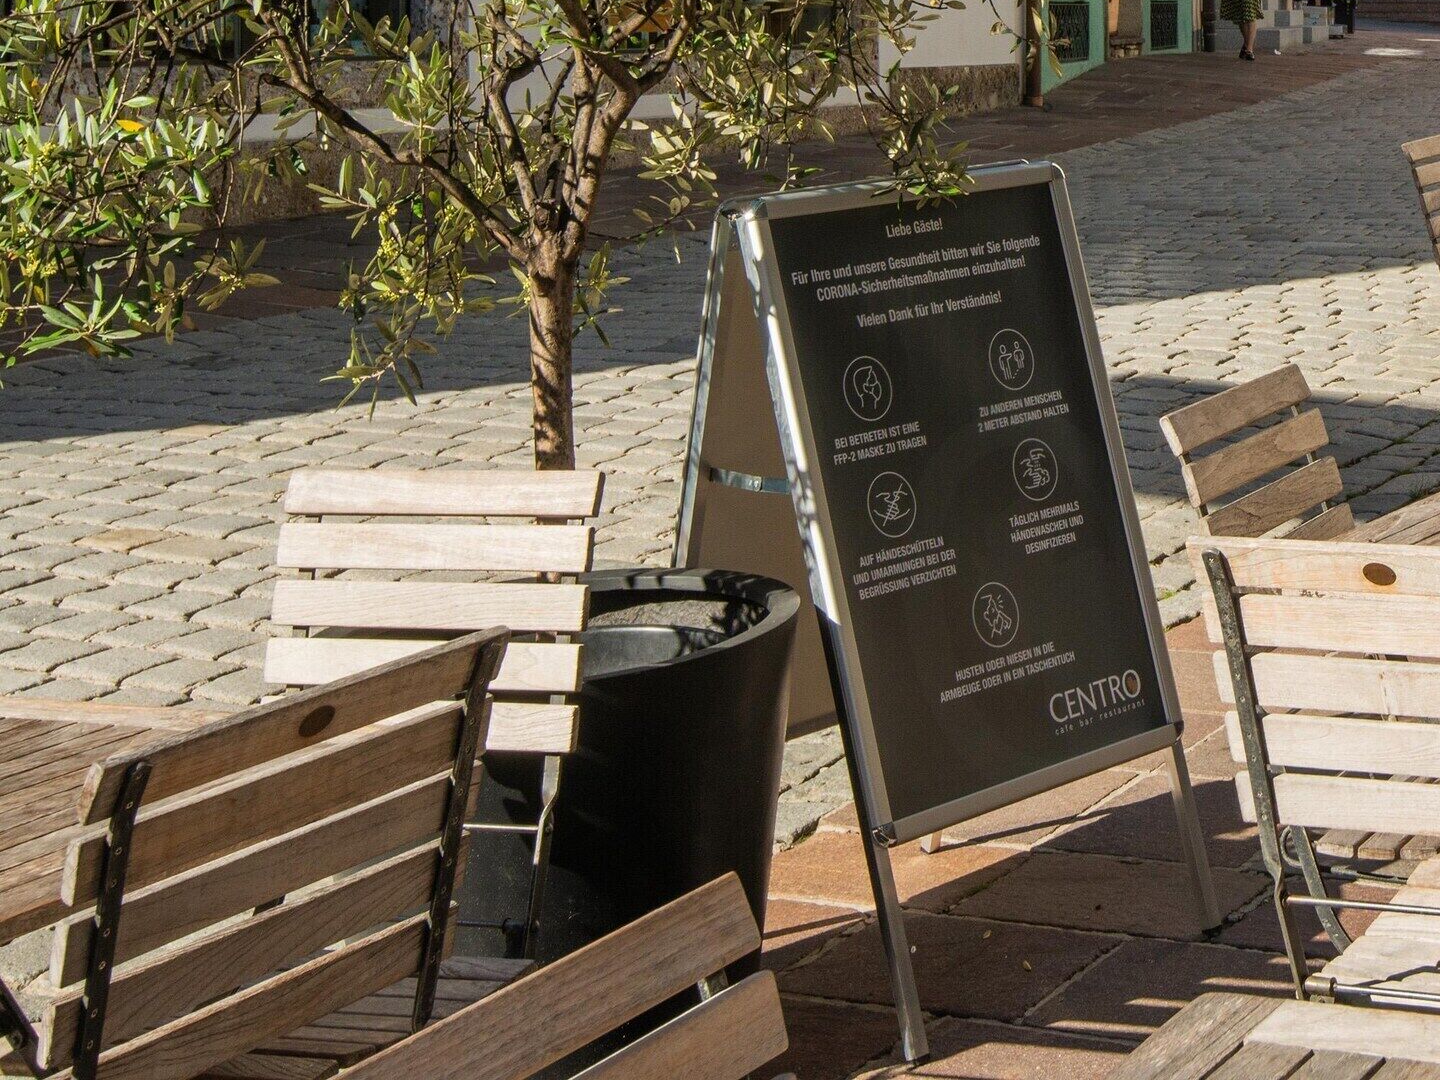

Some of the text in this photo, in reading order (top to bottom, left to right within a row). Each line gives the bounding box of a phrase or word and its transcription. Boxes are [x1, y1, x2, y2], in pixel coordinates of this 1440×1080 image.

[885, 218, 944, 238] Liebe Gäste!
[791, 235, 1041, 286] Für Ihre und unsere Gesundheit bitten wir Sie folgende
[816, 255, 1026, 302] CORONA-Sicherheitsmaßnahmen einzuhalten!
[856, 291, 1002, 327] Vielen Dank für Ihr Verständnis!
[977, 403, 1070, 433] 2 METER ABSTAND HALTEN
[979, 390, 1063, 418] ZU ANDEREN MENSCHEN
[833, 435, 927, 466] FFP-2 MASKE ZU TRAGEN
[834, 421, 920, 450] BEI BETRETEN IST EINE
[1009, 501, 1080, 528] TÄGLICH MEHRMALS
[1010, 514, 1084, 543] HÄNDEWASCHEN UND
[860, 536, 945, 568] AUF HÄNDESCHÜTTELN
[1025, 531, 1077, 554] DESINFIZIEREN
[853, 548, 957, 585] UND UMARMUNGEN BEI DER
[859, 564, 957, 600] BEGRÜSSUNG VERZICHTEN
[940, 651, 1076, 703] ARMBEUGE ODER IN EIN TASCHENTUCH
[955, 641, 1056, 682] HUSTEN ODER NIESEN IN DIE
[1049, 669, 1141, 723] CENTRO
[1078, 717, 1094, 727] bar
[1099, 698, 1146, 721] restaurant
